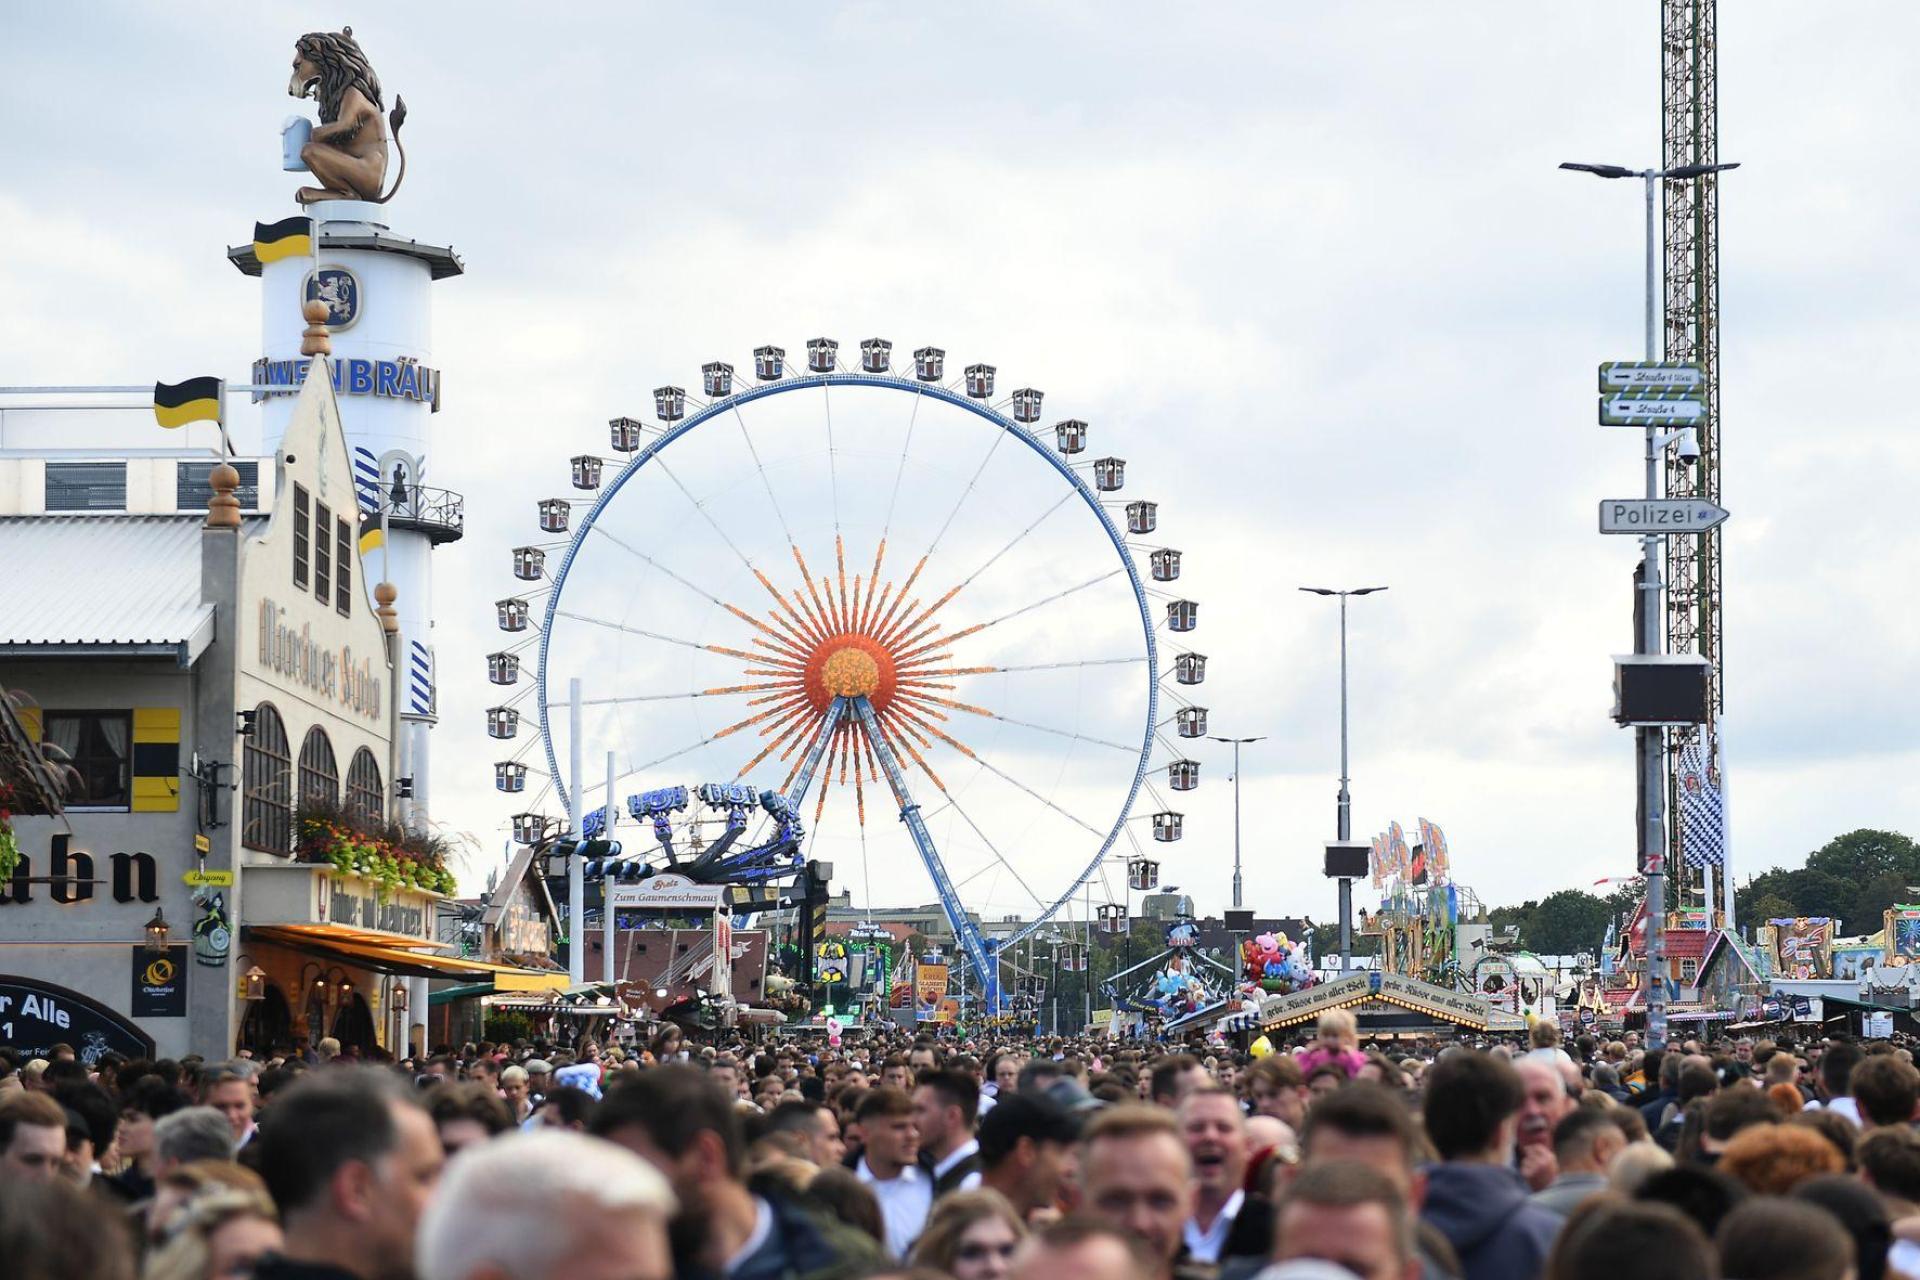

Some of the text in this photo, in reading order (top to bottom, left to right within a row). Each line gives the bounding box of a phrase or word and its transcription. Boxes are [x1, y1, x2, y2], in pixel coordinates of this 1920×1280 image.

[1613, 504, 1692, 524] Polizei
[192, 871, 226, 884] Eingang
[614, 892, 638, 903] Zum
[639, 892, 719, 903] Gaumenschmaus
[1328, 986, 1346, 998] aller
[21, 993, 71, 1030] Alle
